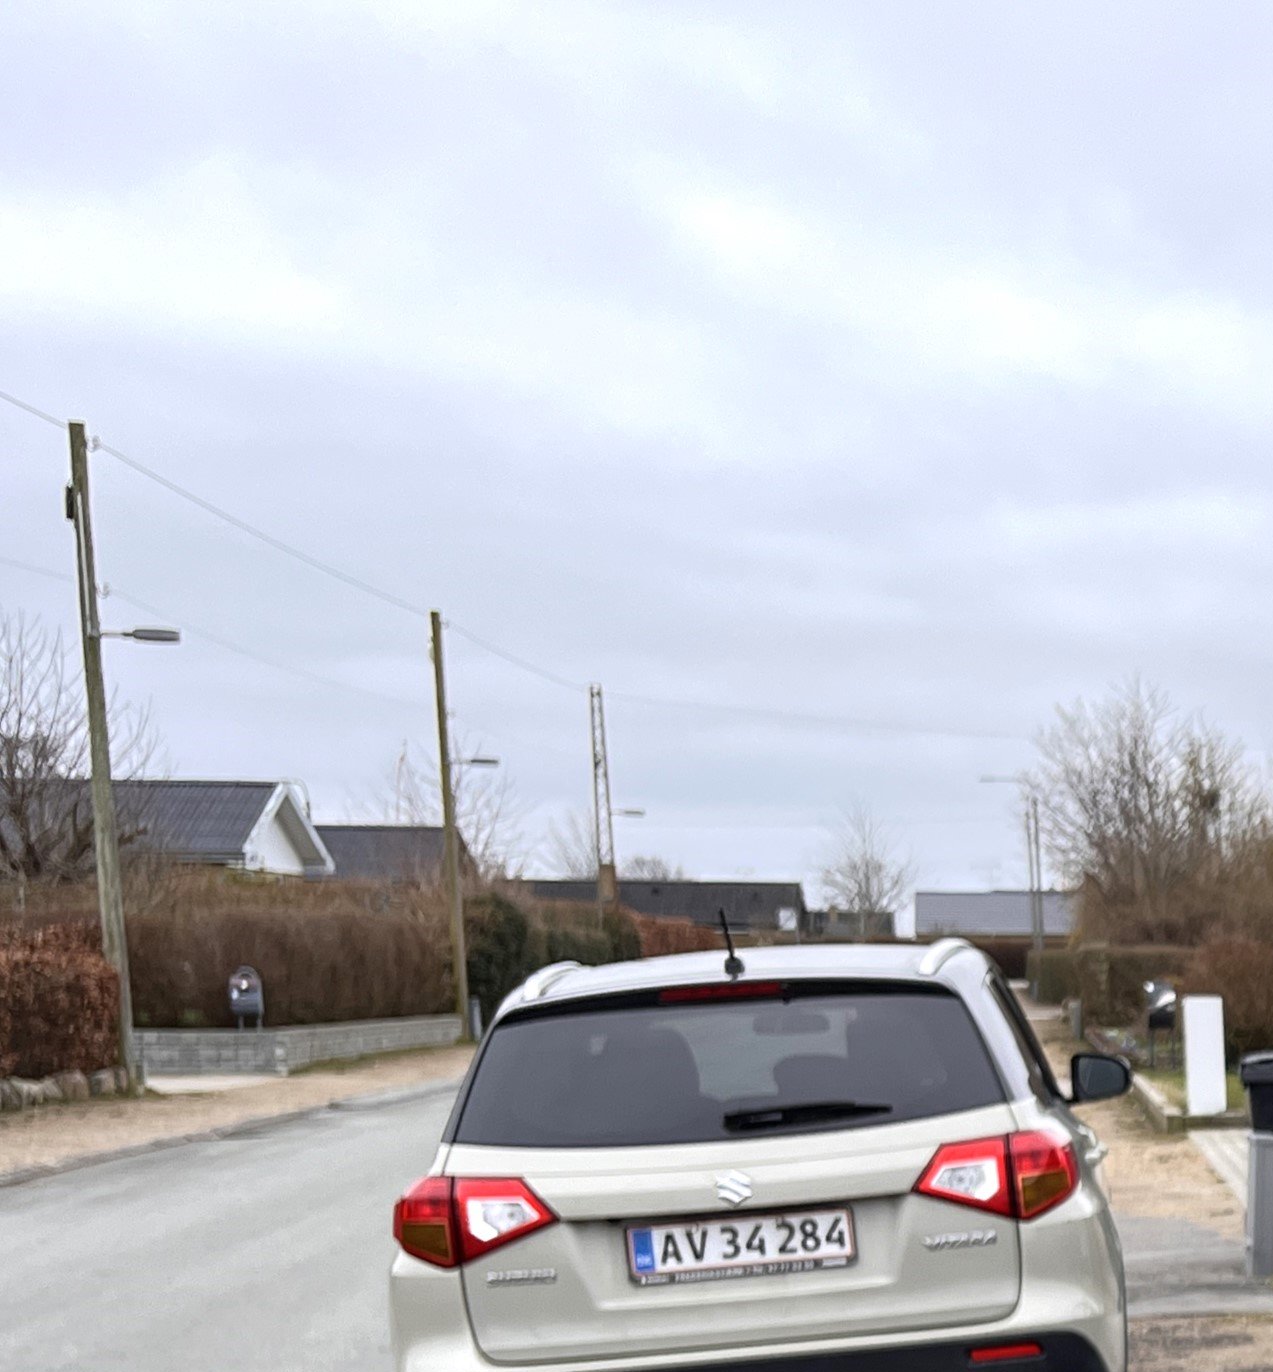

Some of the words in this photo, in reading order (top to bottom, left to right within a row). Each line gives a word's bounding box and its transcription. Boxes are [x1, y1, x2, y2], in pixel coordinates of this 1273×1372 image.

[661, 1229, 708, 1266] AV
[720, 1223, 766, 1259] 34
[776, 1216, 846, 1255] 284
